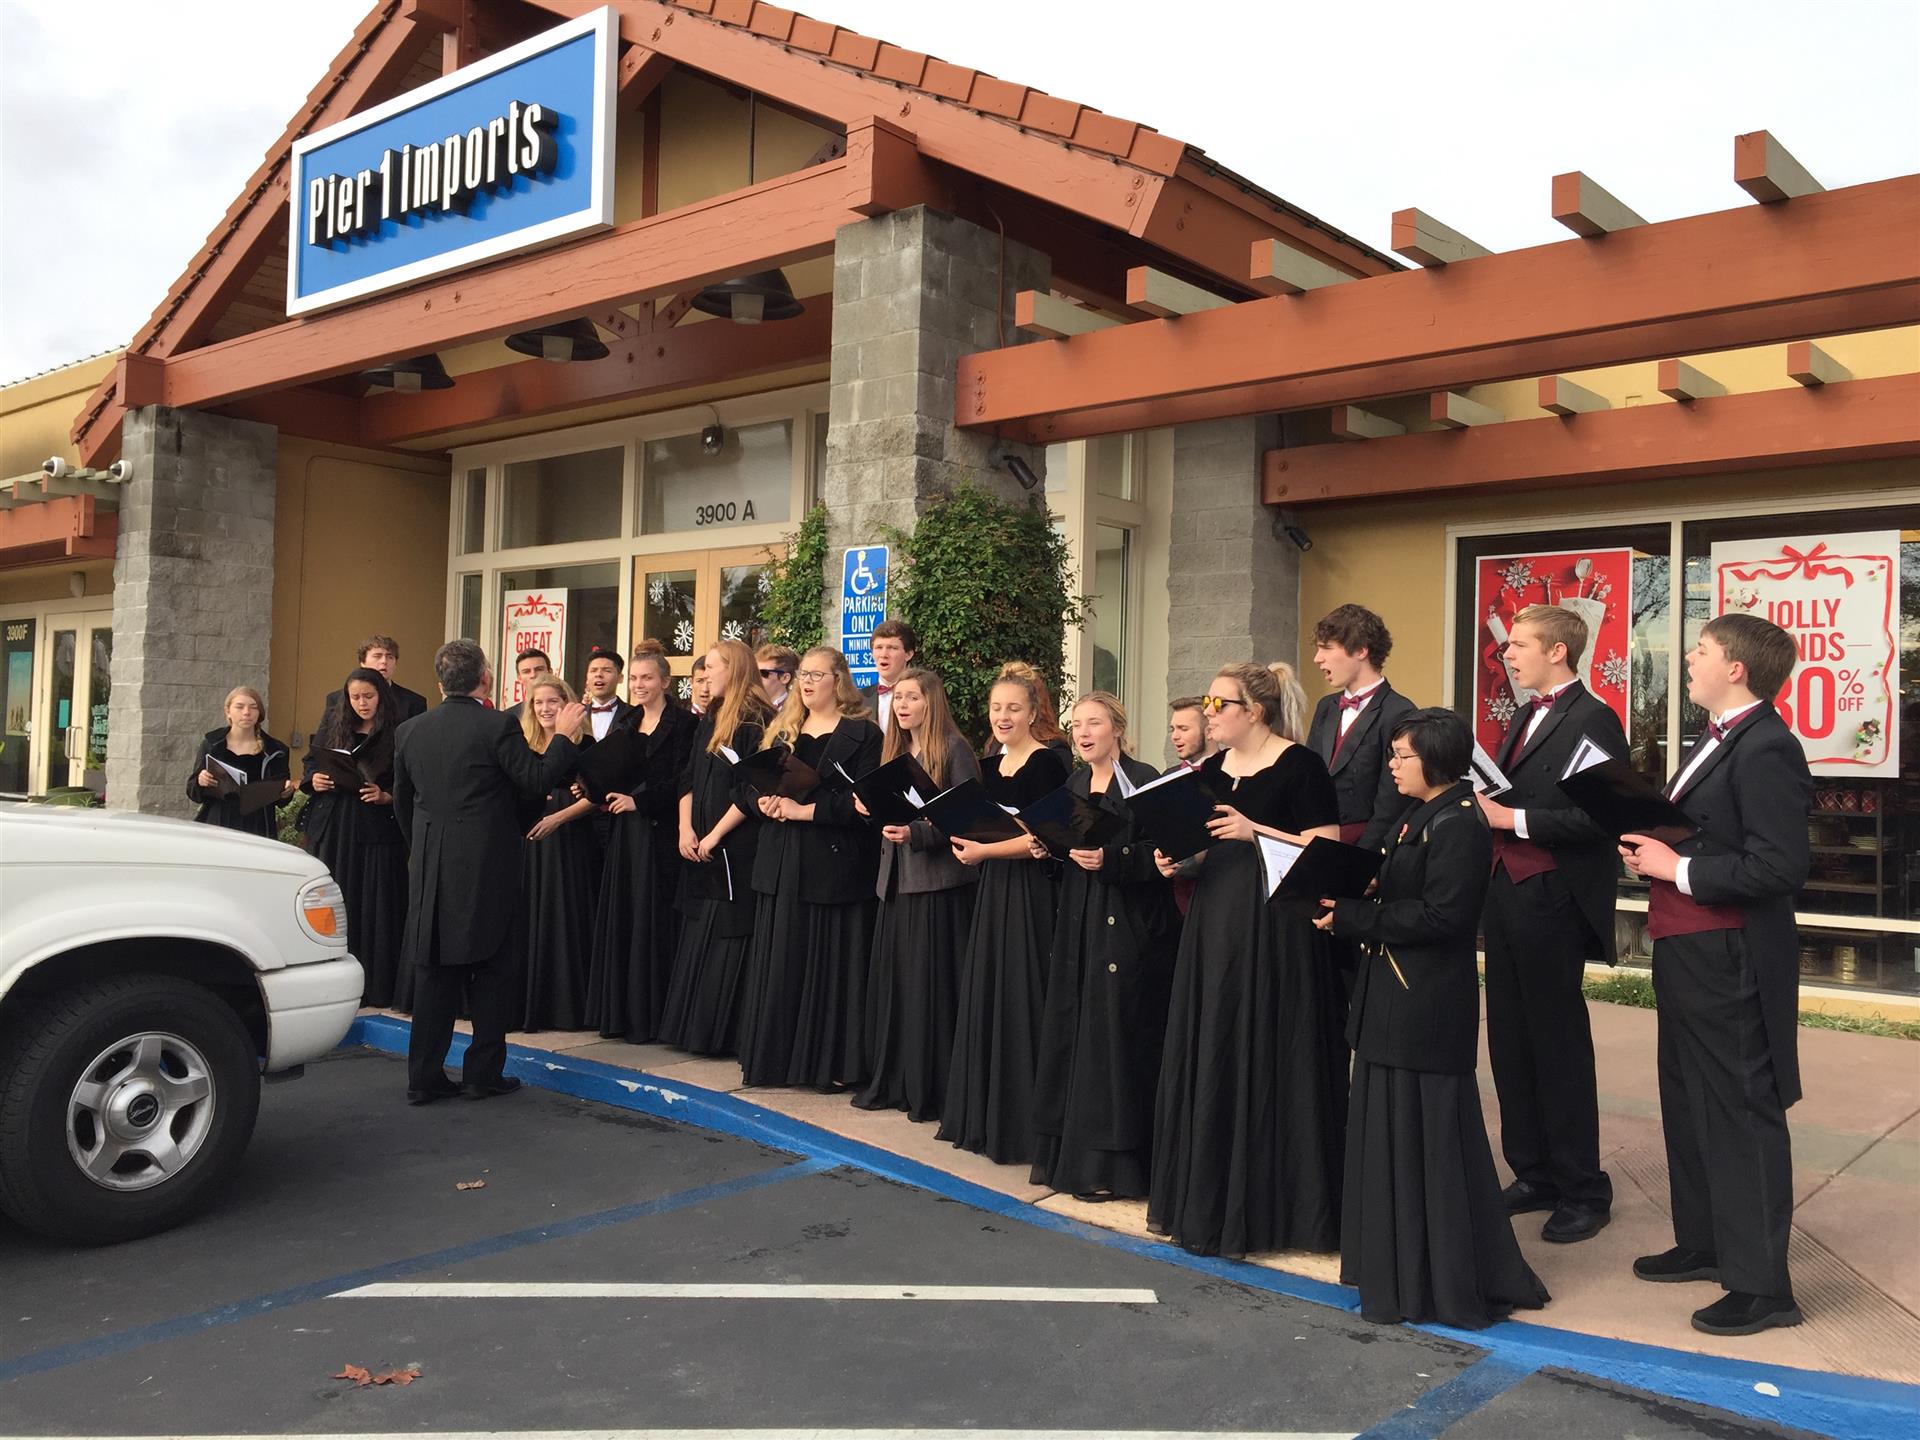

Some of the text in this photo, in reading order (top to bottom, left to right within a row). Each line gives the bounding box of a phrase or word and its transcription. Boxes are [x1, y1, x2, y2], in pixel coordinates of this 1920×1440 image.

[309, 100, 542, 245] Pier 1 imports
[695, 499, 755, 526] 3900 A
[844, 595, 884, 613] PARKING
[7, 624, 28, 641] 3900F
[851, 614, 876, 633] ONLY
[516, 631, 552, 654] GREAT
[1838, 697, 1864, 712] OFF
